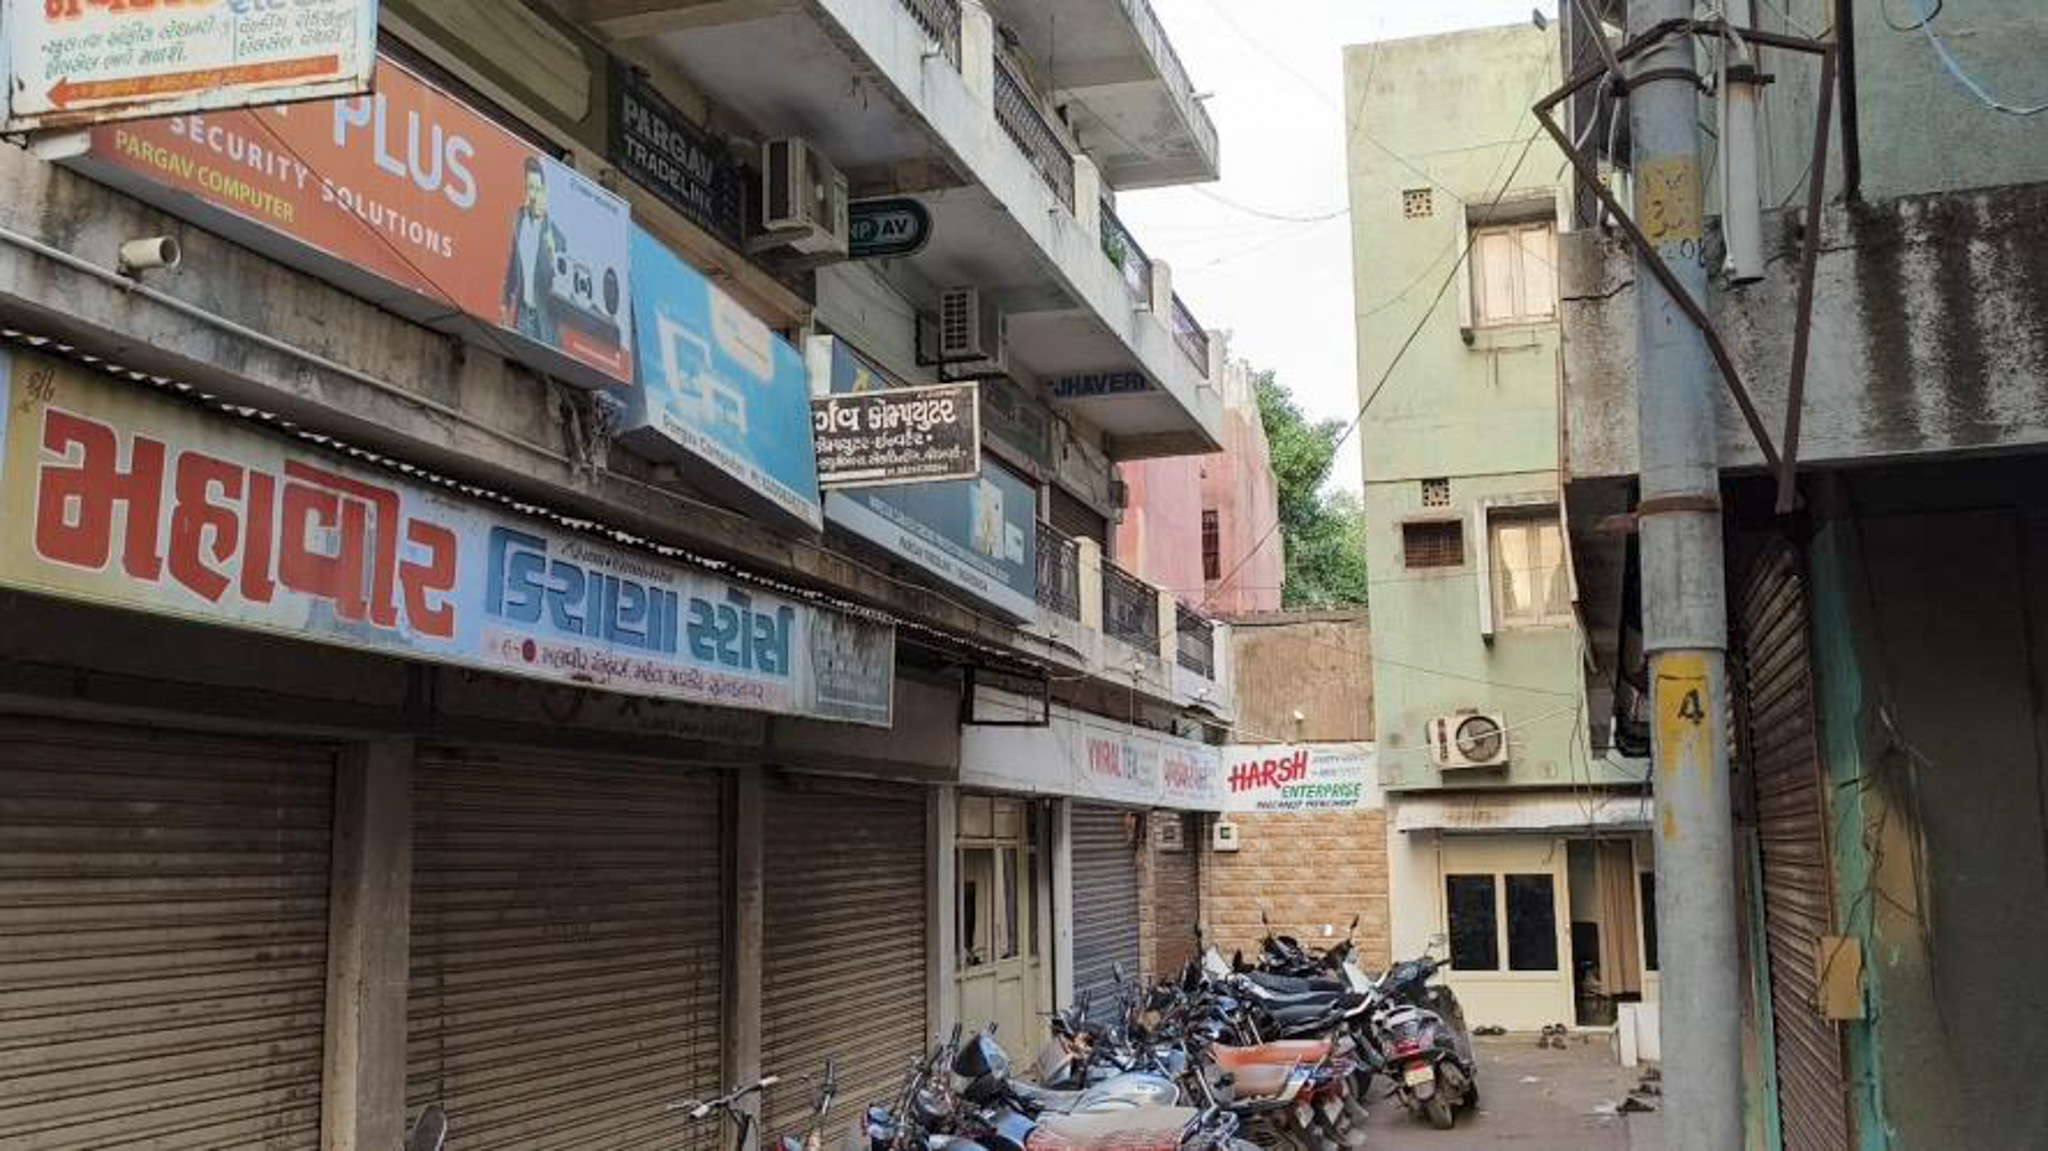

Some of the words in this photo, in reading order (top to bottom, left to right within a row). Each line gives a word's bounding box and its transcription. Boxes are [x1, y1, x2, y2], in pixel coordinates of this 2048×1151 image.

[115, 129, 194, 180] PARGAV
[197, 165, 296, 223] COMPUTER
[169, 112, 308, 190] SECURITY
[322, 178, 452, 258] SOLUTIONS
[334, 92, 477, 208] PLUS
[623, 93, 713, 186] PARGAV
[36, 407, 457, 639] મહાવીર
[486, 525, 678, 656] કિરાણા
[1677, 688, 1704, 724] 4
[1227, 750, 1308, 794] HARSH
[1281, 783, 1362, 799] ENTERPRISE
